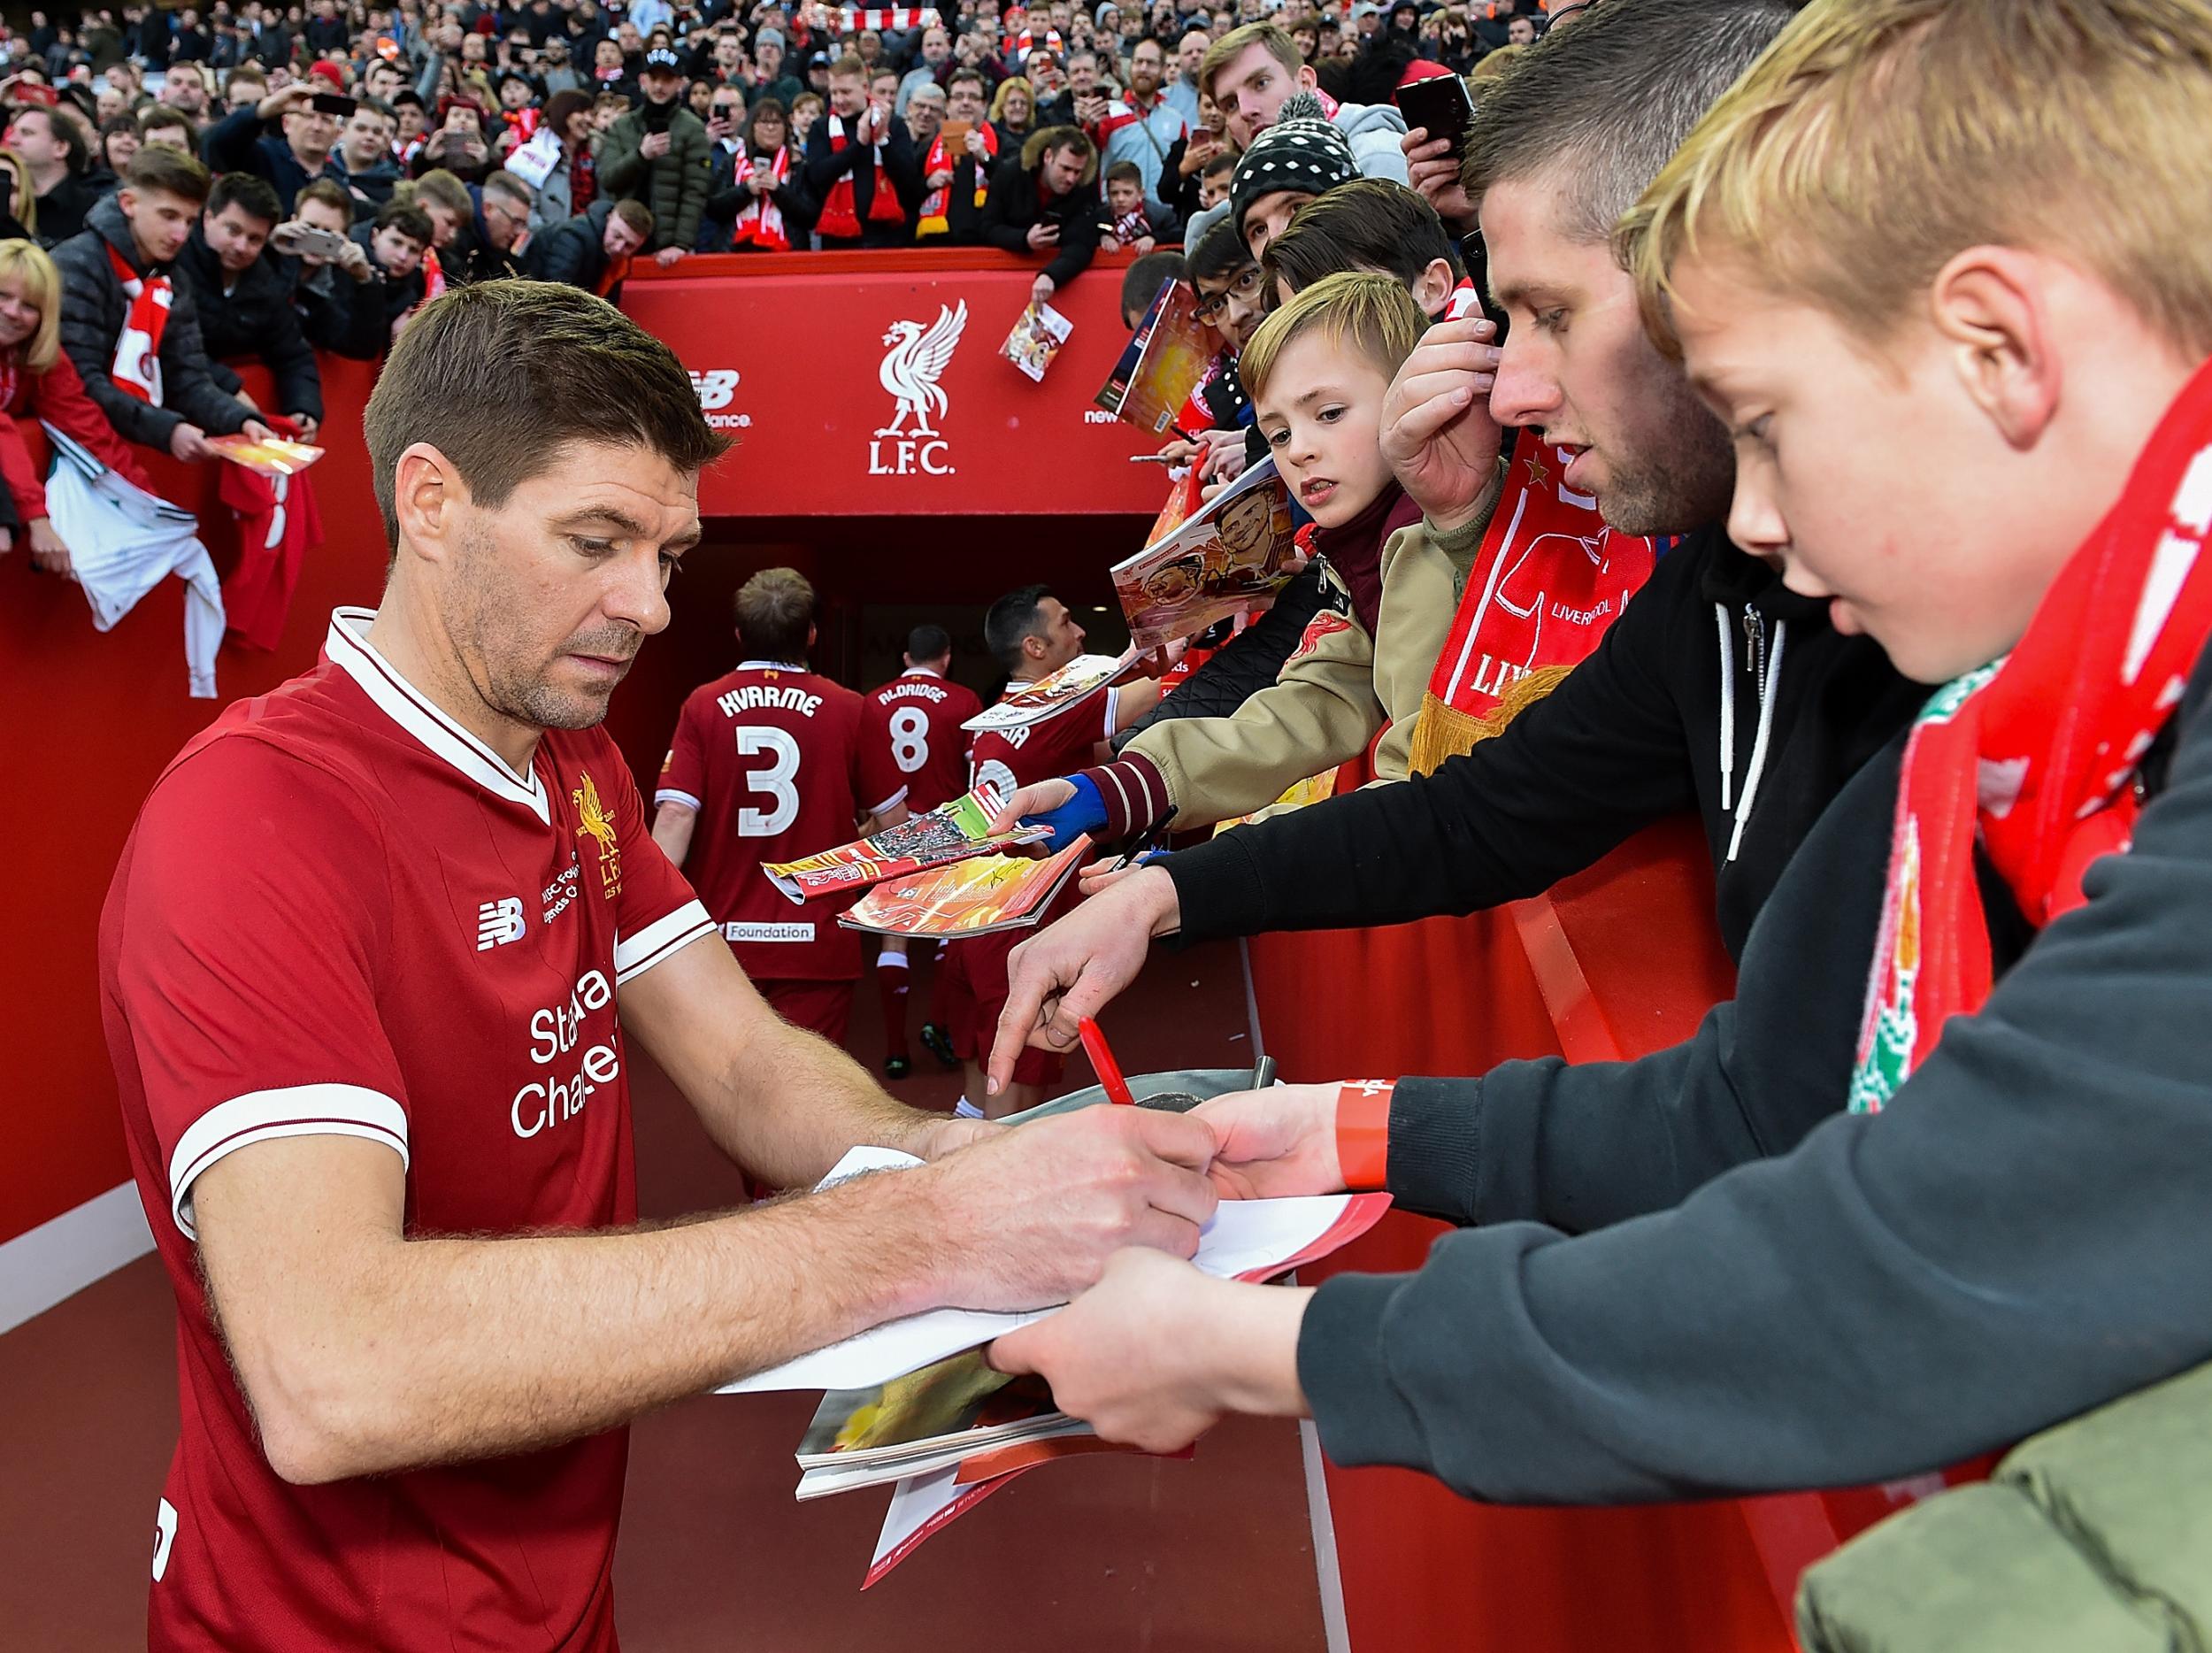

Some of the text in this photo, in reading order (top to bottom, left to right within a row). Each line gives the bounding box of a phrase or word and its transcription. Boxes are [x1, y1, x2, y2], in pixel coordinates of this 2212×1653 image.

[868, 441, 956, 475] L.F.C.
[717, 686, 824, 718] KVARME
[878, 684, 949, 705] ALDRIDGE
[889, 706, 929, 773] 8
[736, 726, 801, 837] 3
[731, 925, 810, 938] Foundation
